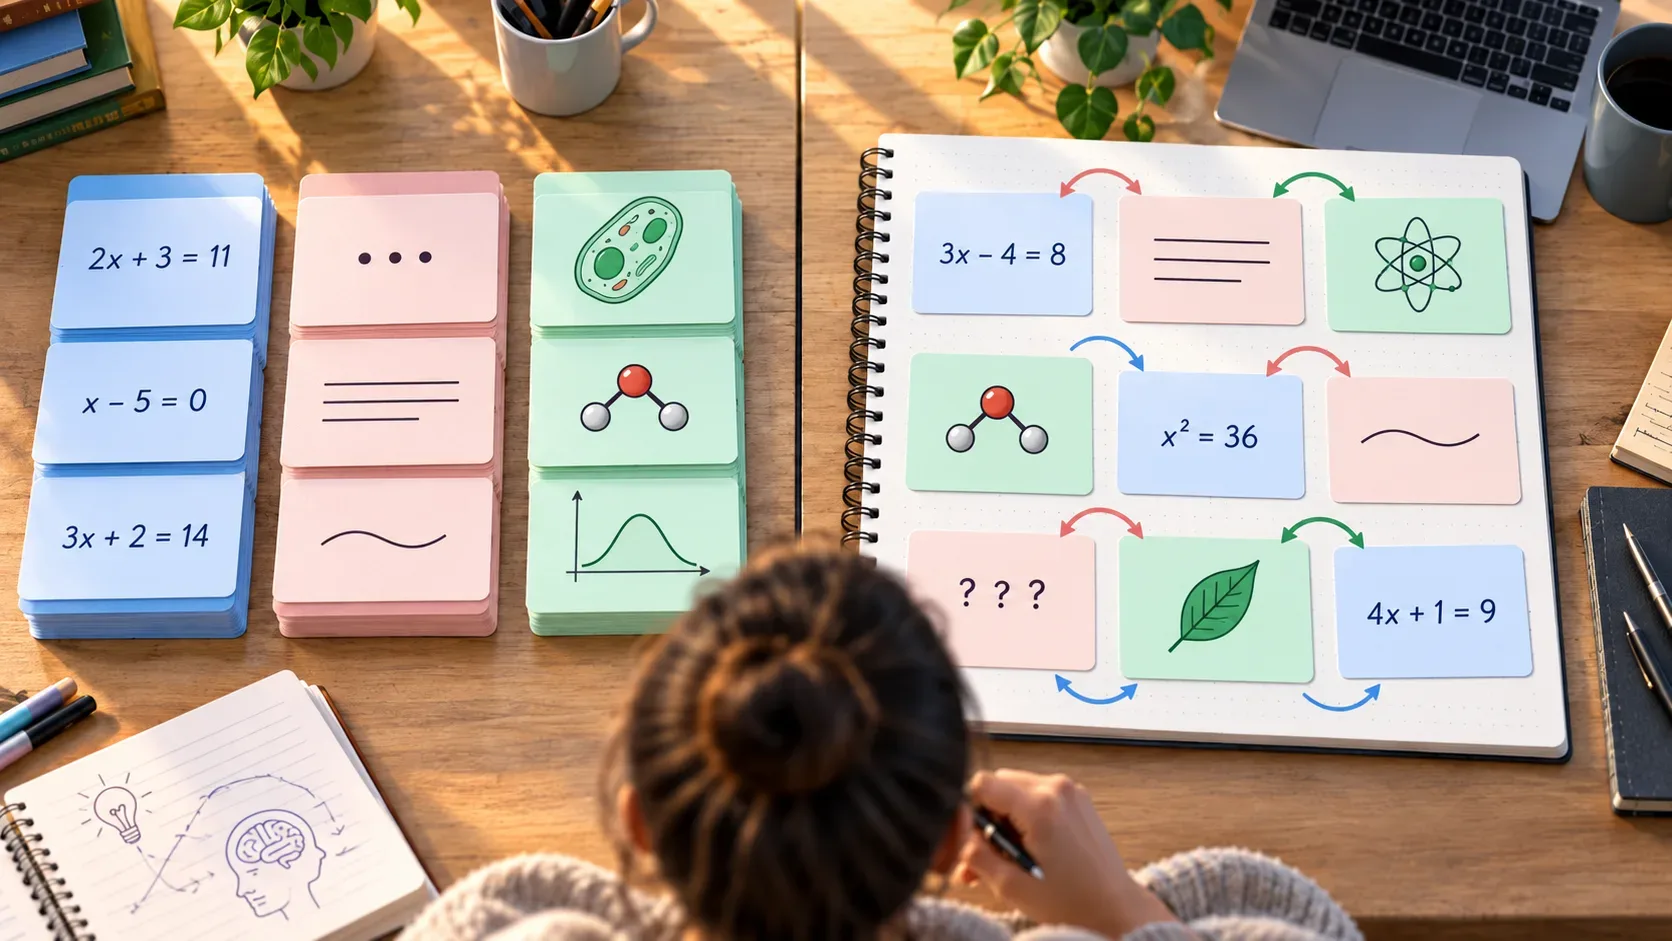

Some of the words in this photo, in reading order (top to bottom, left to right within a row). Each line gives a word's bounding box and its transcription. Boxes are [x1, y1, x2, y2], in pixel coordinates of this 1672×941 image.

[89, 247, 123, 271] 2x
[132, 252, 148, 267] +
[156, 245, 172, 269] 3
[183, 253, 198, 263] =
[211, 244, 231, 268] 11
[939, 242, 970, 265] 3x
[1001, 242, 1017, 266] 4
[1026, 251, 1041, 260] =
[1050, 242, 1066, 266] 8
[83, 397, 100, 413] x
[134, 389, 152, 413] 5
[162, 397, 178, 407] =
[189, 388, 207, 412] 0
[1199, 433, 1214, 442] =
[1224, 424, 1258, 449] 36
[62, 525, 95, 549] 3x
[104, 530, 120, 546] +
[129, 524, 146, 548] 2
[156, 532, 171, 542] =
[182, 523, 209, 548] 14
[959, 577, 976, 607] ?
[994, 580, 1010, 609] ?
[1028, 579, 1046, 610] ?
[1366, 601, 1400, 626] 4x
[1409, 606, 1425, 622] +
[1434, 599, 1443, 625] 1
[1454, 608, 1470, 618] =
[1480, 598, 1496, 624] 9
